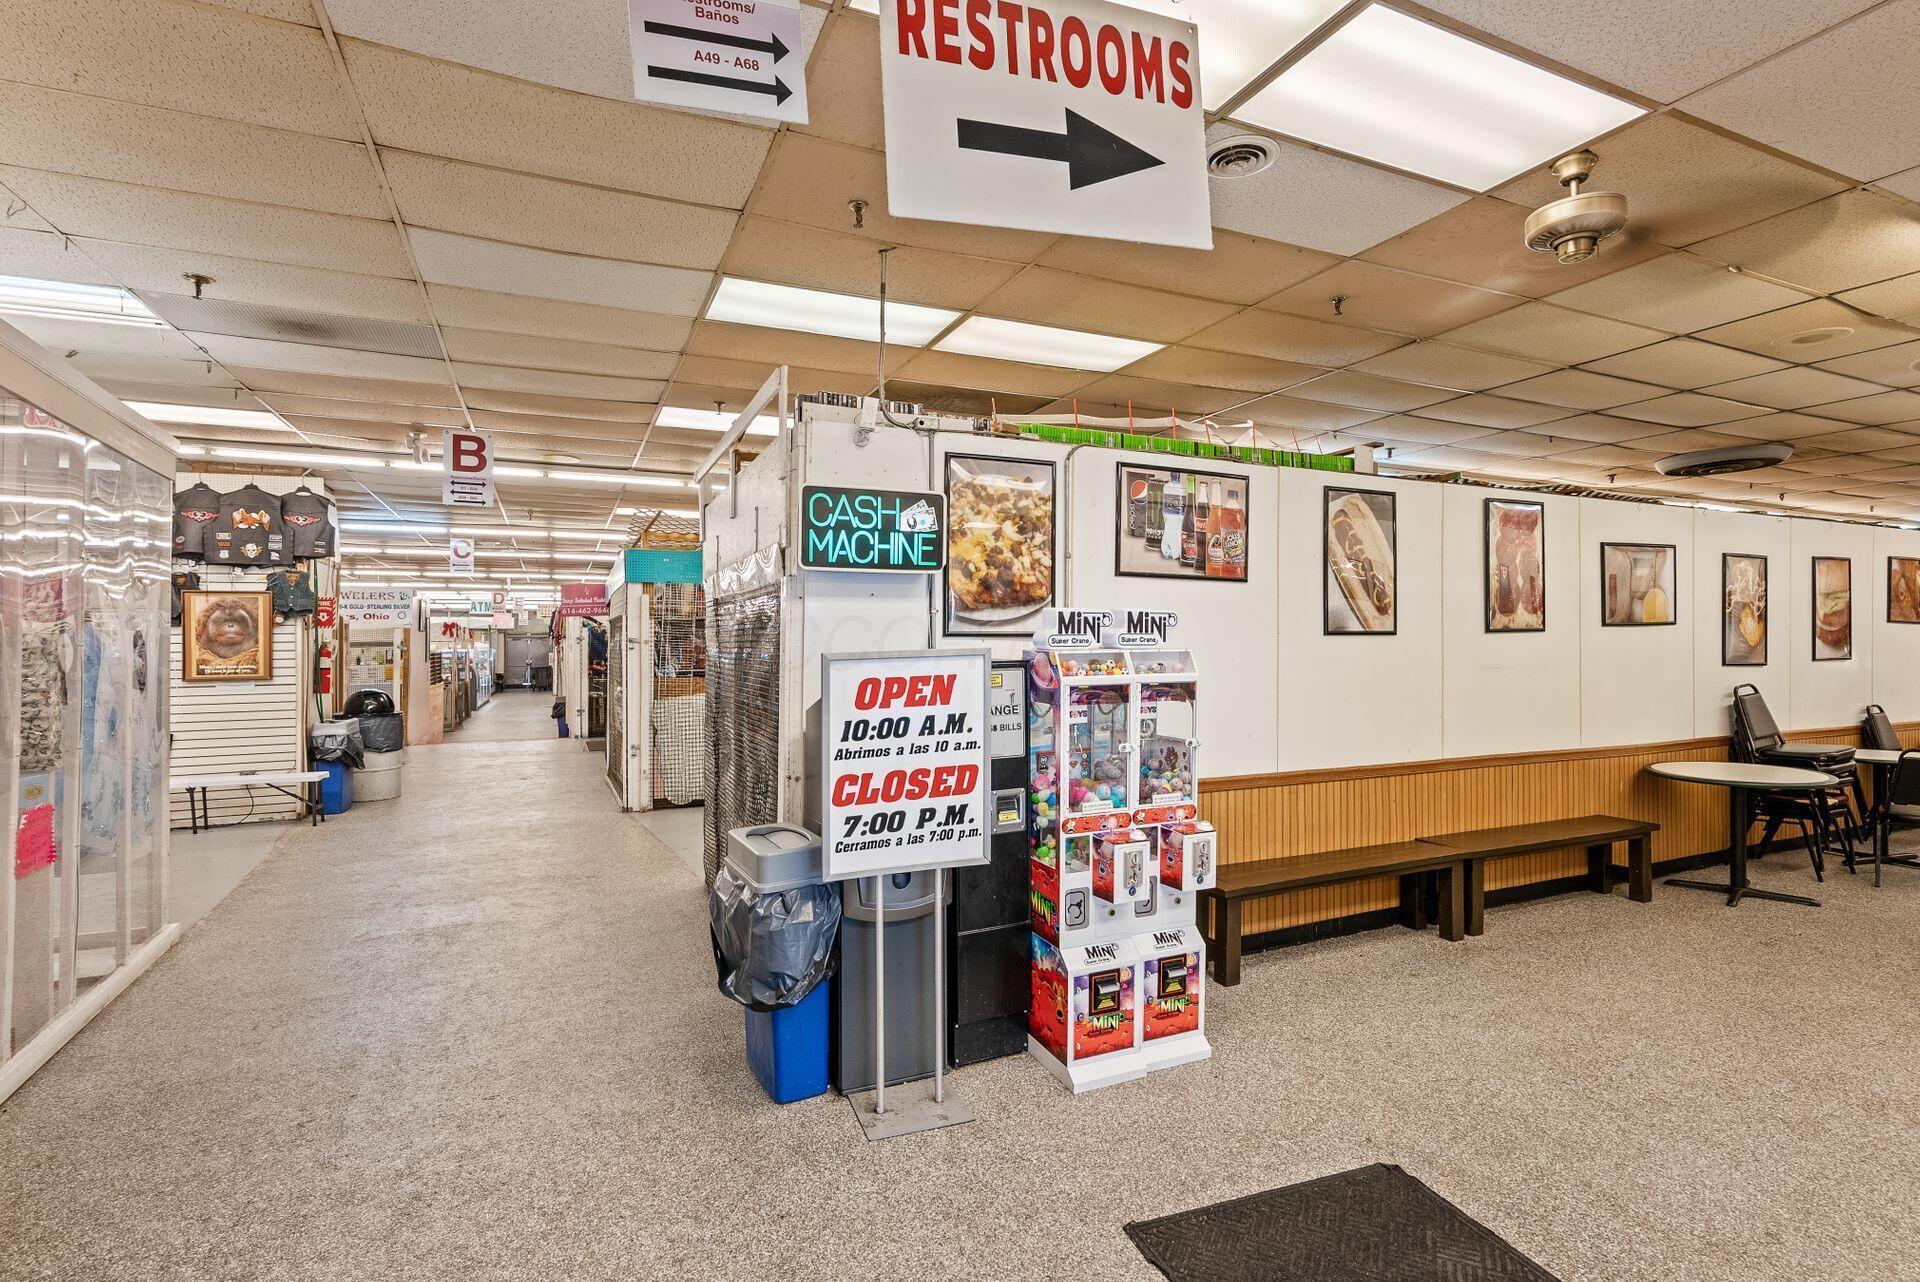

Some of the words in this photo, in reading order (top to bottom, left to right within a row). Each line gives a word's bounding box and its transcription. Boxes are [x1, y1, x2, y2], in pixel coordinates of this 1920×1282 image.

[695, 6, 739, 24] Baños
[693, 50, 720, 65] A49
[733, 57, 760, 71] A68
[896, 0, 1193, 109] RESTROOMS
[453, 433, 487, 472] B
[808, 492, 900, 530] CASH
[453, 539, 471, 559] C
[808, 528, 937, 566] MACHINE
[493, 592, 505, 605] D
[363, 612, 390, 620] Ohio
[1051, 637, 1069, 645] Super
[1120, 636, 1138, 644] Super
[854, 673, 957, 711] OPEN
[840, 716, 910, 742] 10:00
[918, 712, 973, 737] A.M.
[1000, 723, 1022, 732] BILLS
[833, 747, 891, 761] Abrimos
[896, 746, 905, 756] a
[908, 743, 929, 755] las
[934, 741, 949, 752] 10
[953, 740, 981, 751] a.m.
[831, 764, 980, 807] CLOSED
[842, 810, 907, 839] 7:00
[915, 803, 975, 830] P.M.
[834, 837, 891, 854] Cerramos
[895, 837, 903, 847] a
[906, 833, 925, 845] las
[929, 828, 954, 843] 7:00
[957, 827, 982, 842] p.m.
